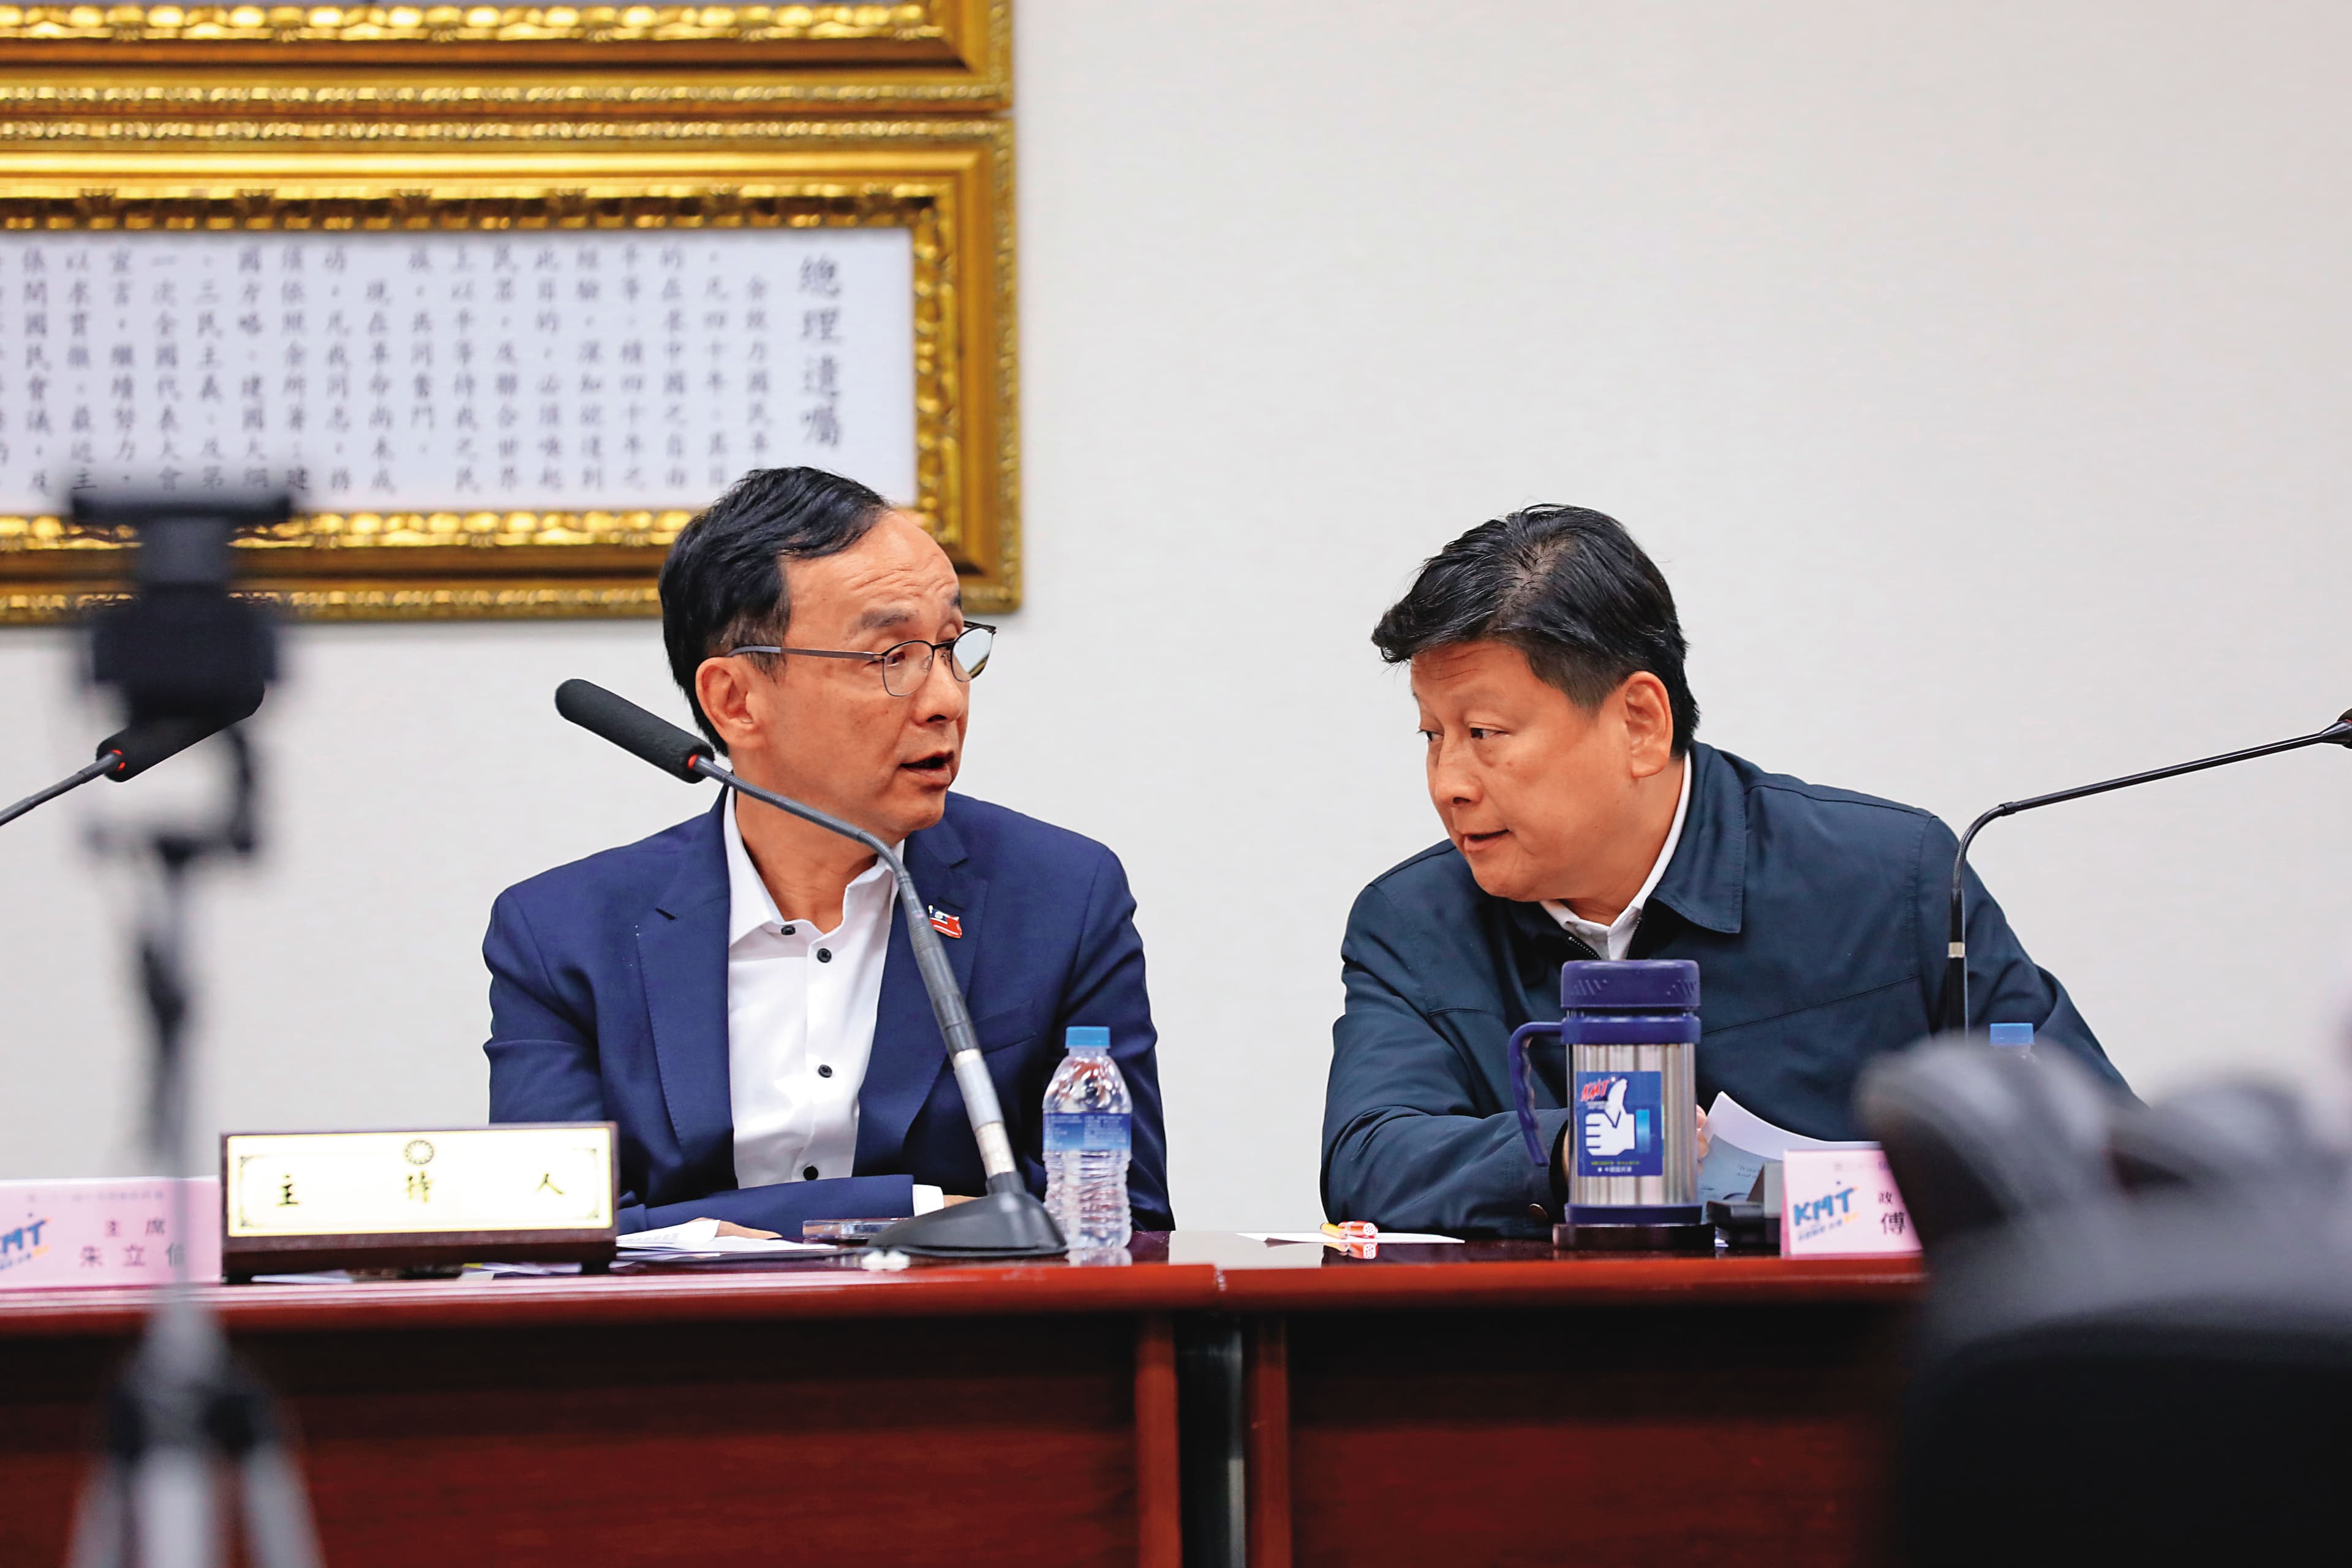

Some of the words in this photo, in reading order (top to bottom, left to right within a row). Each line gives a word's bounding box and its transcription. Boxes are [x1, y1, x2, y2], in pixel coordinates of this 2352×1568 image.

[799, 255, 841, 447] 總理遺囑
[1580, 1079, 1611, 1102] KMT
[1793, 1186, 1858, 1226] KMT
[0, 1218, 49, 1254] MT
[105, 1219, 165, 1237] 主席
[1881, 1210, 1906, 1236] 傅
